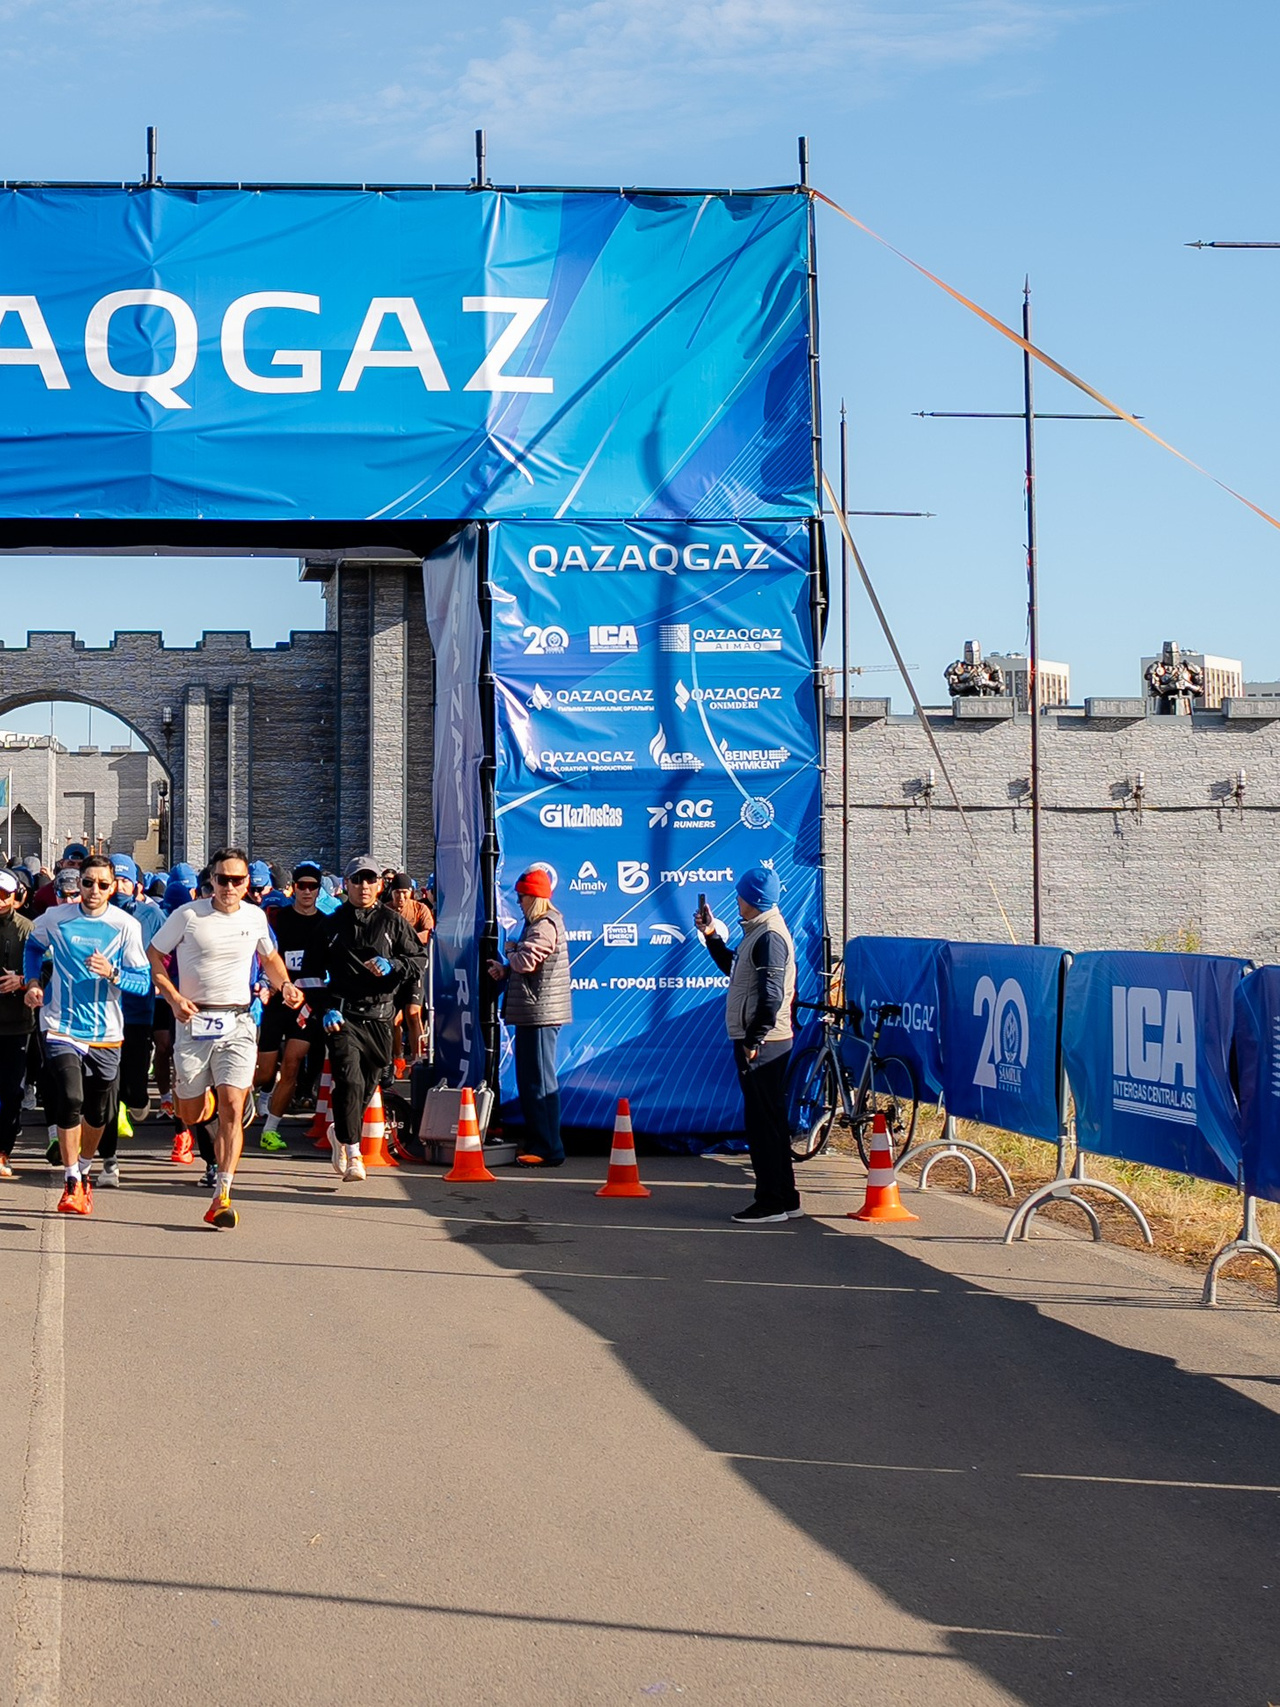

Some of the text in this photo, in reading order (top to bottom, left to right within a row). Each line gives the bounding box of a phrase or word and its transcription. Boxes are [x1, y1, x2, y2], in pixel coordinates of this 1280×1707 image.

[528, 543, 769, 577] QAZAQGAZ
[523, 625, 570, 655] 20
[589, 625, 638, 645] ICA
[693, 628, 782, 641] QAZAQGAZ
[556, 689, 654, 704] QAZAQGAZ
[691, 687, 782, 702] QAZAQGAZ
[540, 750, 635, 764] QAZAQGAZ
[660, 752, 694, 763] AGP
[724, 750, 768, 760] BEINEU
[725, 760, 781, 770] SHYMKENT
[563, 804, 623, 827] KazRosGas
[675, 799, 714, 818] QG
[661, 867, 733, 886] mystart
[569, 878, 607, 892] Almaty
[649, 934, 672, 945] ANTA
[610, 977, 657, 991] ГОРОД
[658, 976, 684, 989] БЕЗ
[204, 1017, 224, 1031] 75
[972, 975, 1029, 1089] 20
[1112, 985, 1197, 1089] ICA
[1147, 1086, 1180, 1107] CENTRAL
